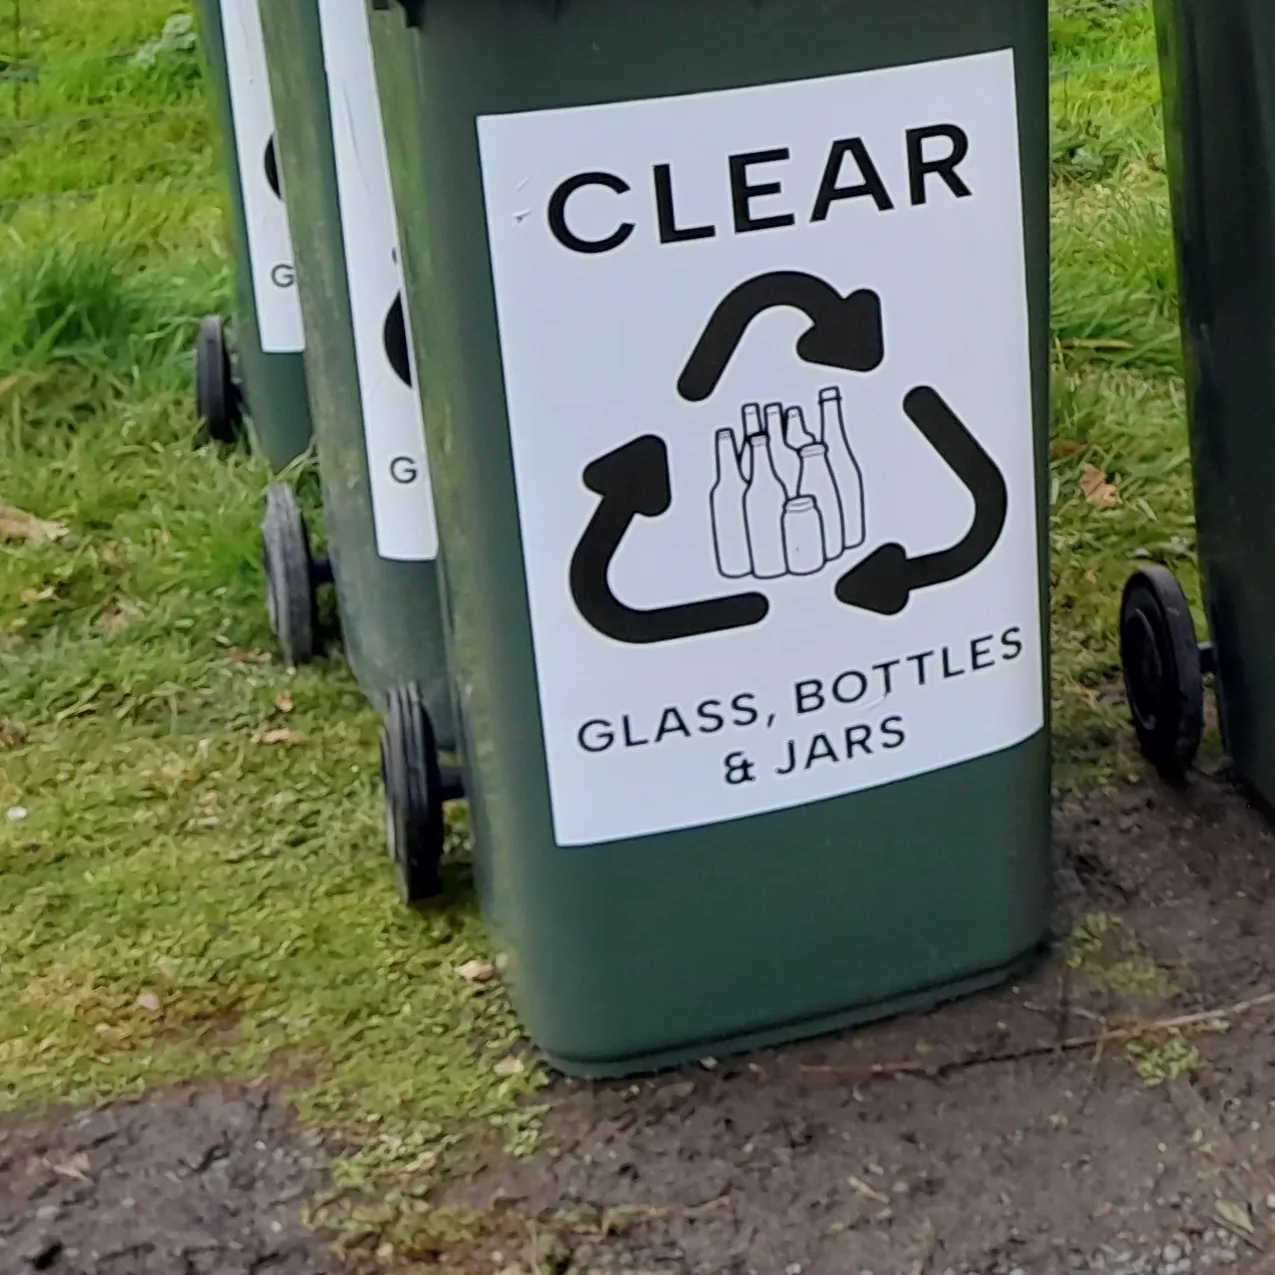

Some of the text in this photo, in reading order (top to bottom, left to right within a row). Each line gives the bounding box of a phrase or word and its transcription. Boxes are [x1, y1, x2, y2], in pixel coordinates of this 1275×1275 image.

[547, 123, 974, 255] CLEAR
[577, 627, 1023, 754] GLASS, BOTTLES
[723, 714, 905, 785] & JARS
